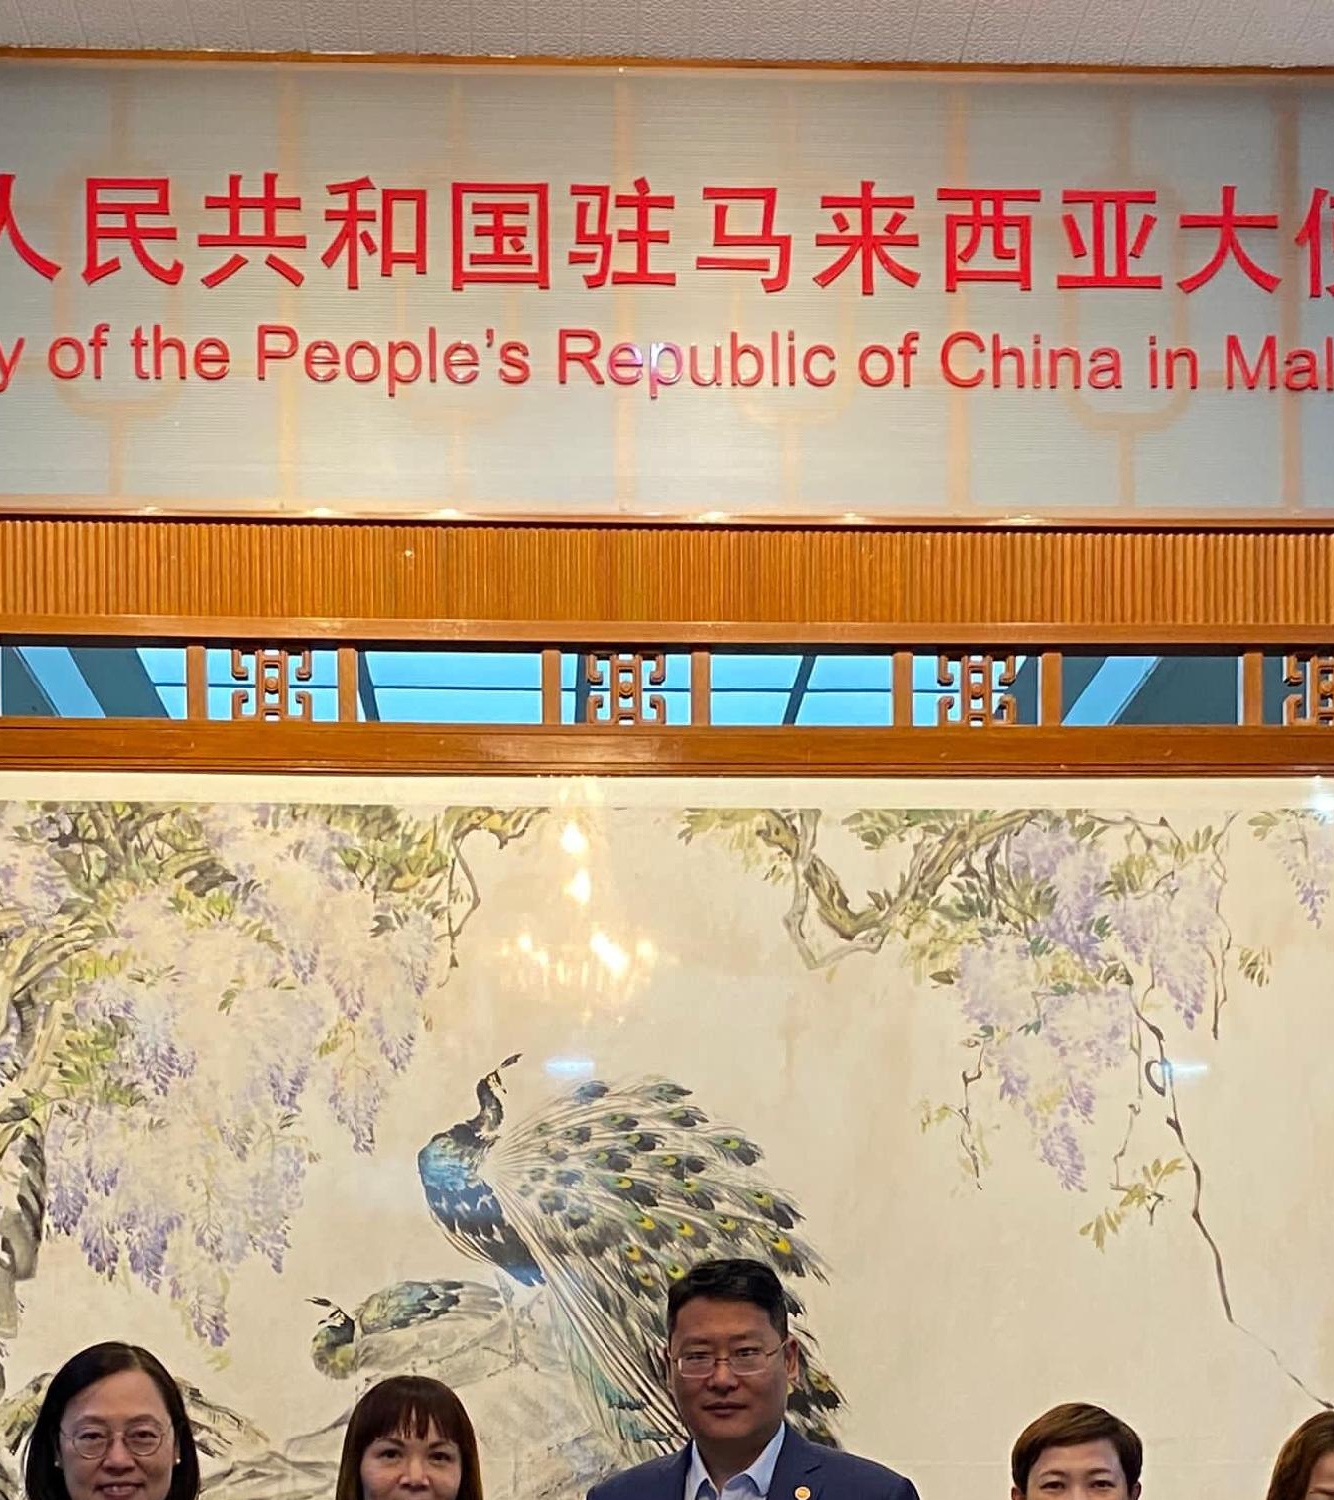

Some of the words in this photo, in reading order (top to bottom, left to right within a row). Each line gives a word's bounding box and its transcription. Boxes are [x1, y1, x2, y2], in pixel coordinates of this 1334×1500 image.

[47, 323, 111, 381] of
[130, 324, 231, 381] the
[256, 324, 532, 397] People's
[557, 327, 837, 399] Republic
[857, 330, 919, 388] of
[939, 330, 1123, 391] China
[1149, 335, 1200, 391] in
